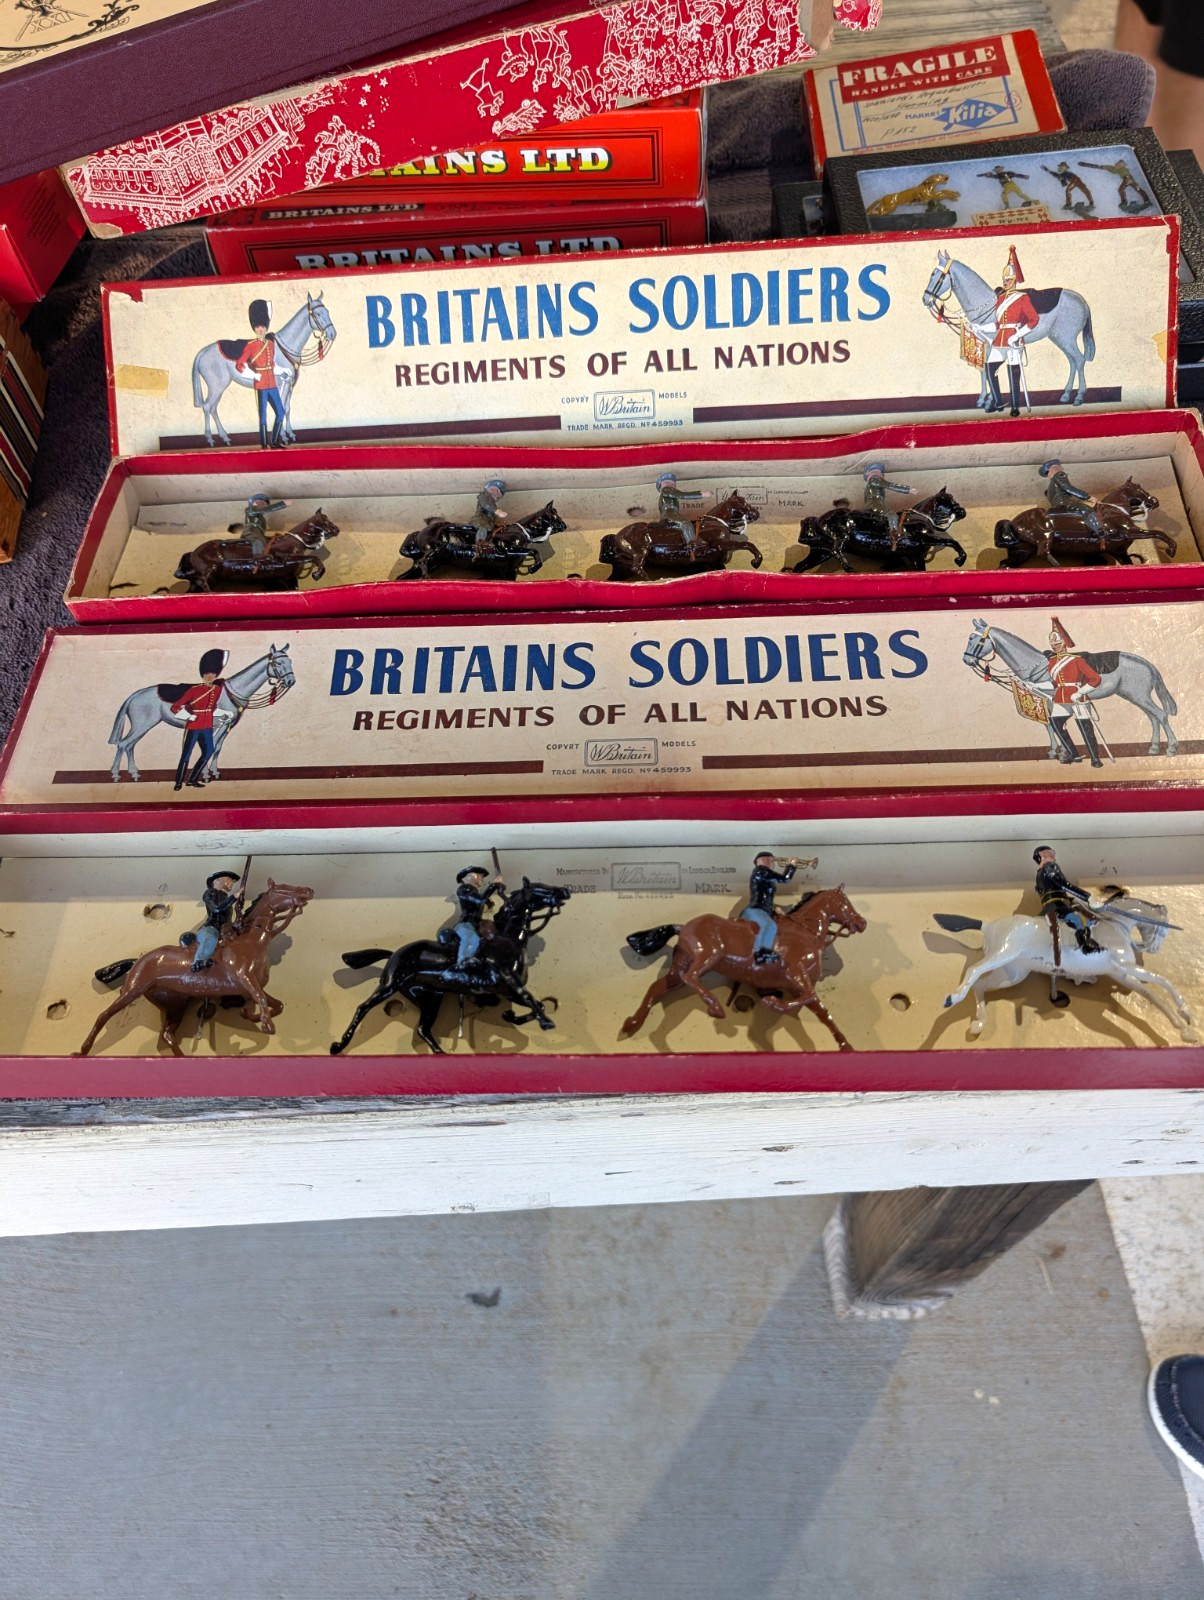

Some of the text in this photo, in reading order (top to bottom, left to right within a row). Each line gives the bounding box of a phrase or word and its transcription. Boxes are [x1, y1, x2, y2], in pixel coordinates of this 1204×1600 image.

[841, 45, 997, 88] FRAGILE
[851, 66, 993, 97] HANDLE WITH CARE
[949, 102, 998, 124] Kilia
[369, 147, 610, 177] AINS LTD
[268, 203, 418, 219] BRITAINS LTD
[295, 236, 620, 270] BRITAINS LTD
[366, 264, 891, 348] BRITAINS SOLDIERS
[396, 339, 851, 387] REGIMENTS OF ALL NATIONS
[658, 391, 688, 399] MODELS
[593, 422, 613, 430] MARK
[778, 500, 806, 508] MARK
[329, 629, 929, 696] BRITAINS SOLDIERS
[353, 695, 888, 731] REGIMENTS OF ALL NATIONS
[694, 882, 732, 893] MARK
